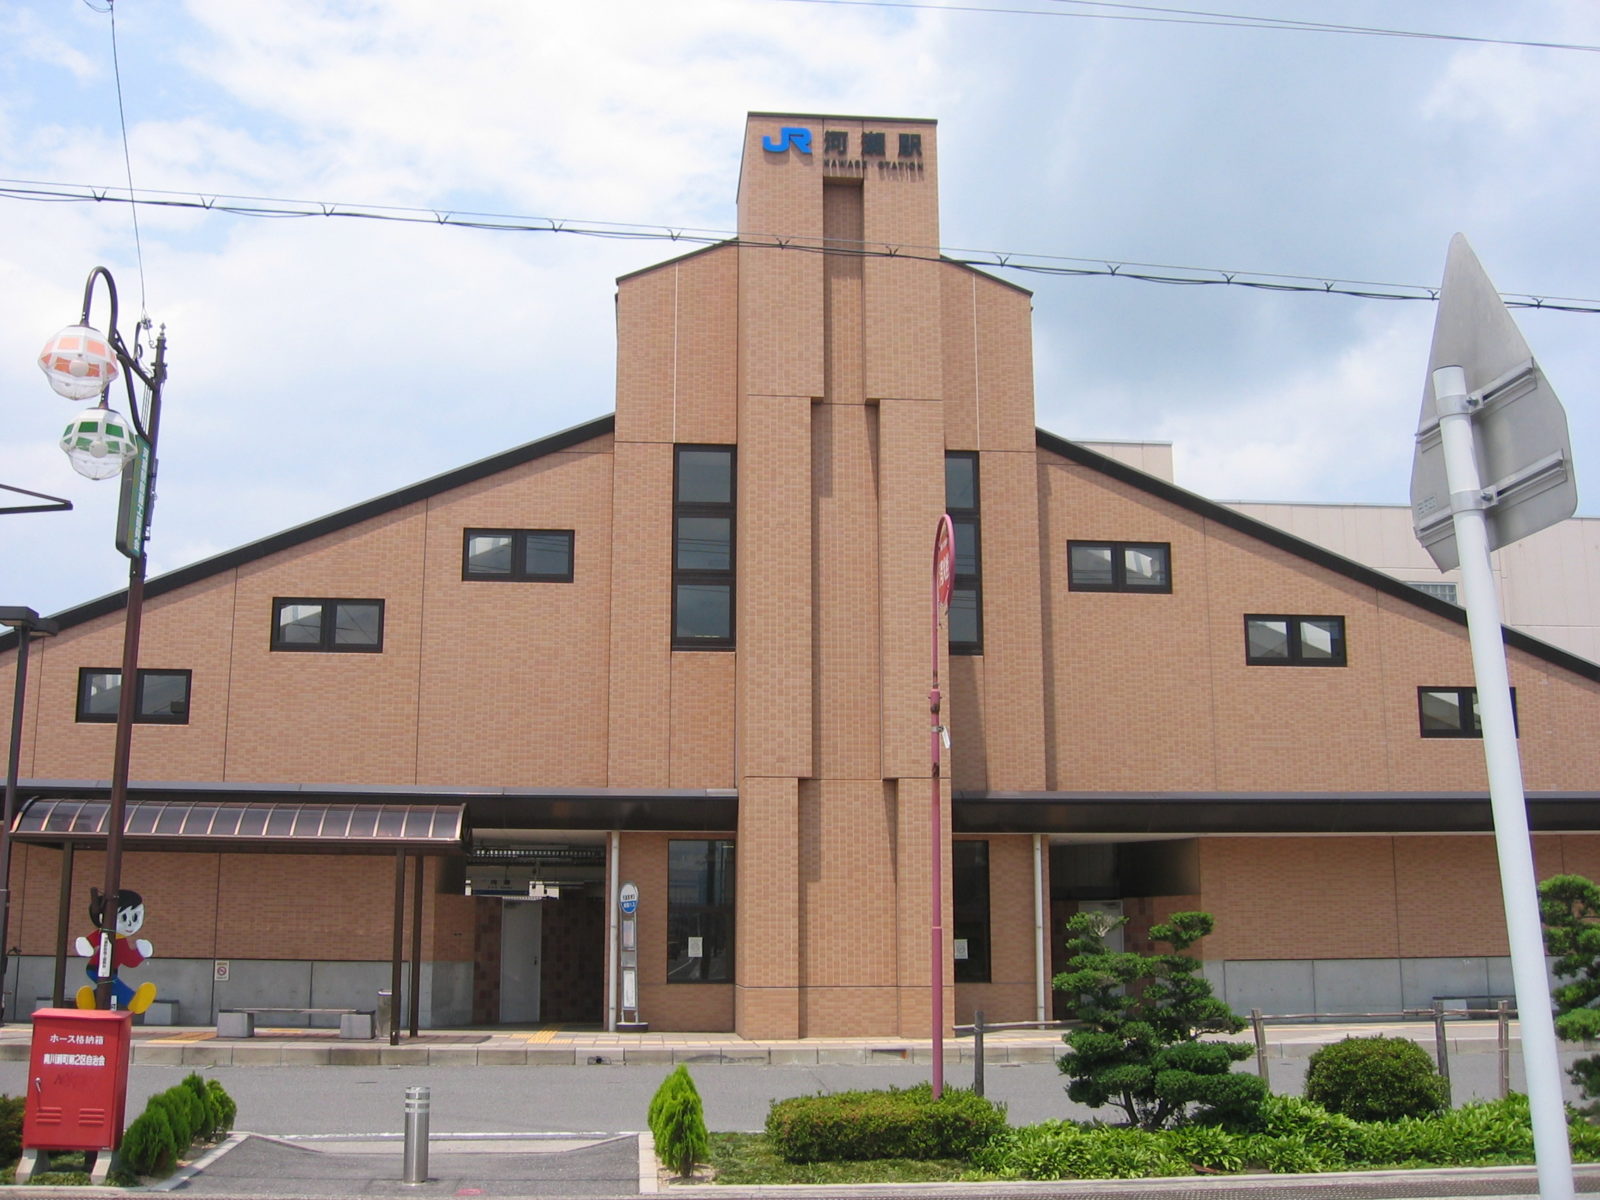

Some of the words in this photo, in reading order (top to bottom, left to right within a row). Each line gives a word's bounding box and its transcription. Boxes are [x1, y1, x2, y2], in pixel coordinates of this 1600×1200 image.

[762, 127, 812, 153] JR
[877, 160, 923, 171] STATION
[49, 1033, 104, 1045] ホース格納箱
